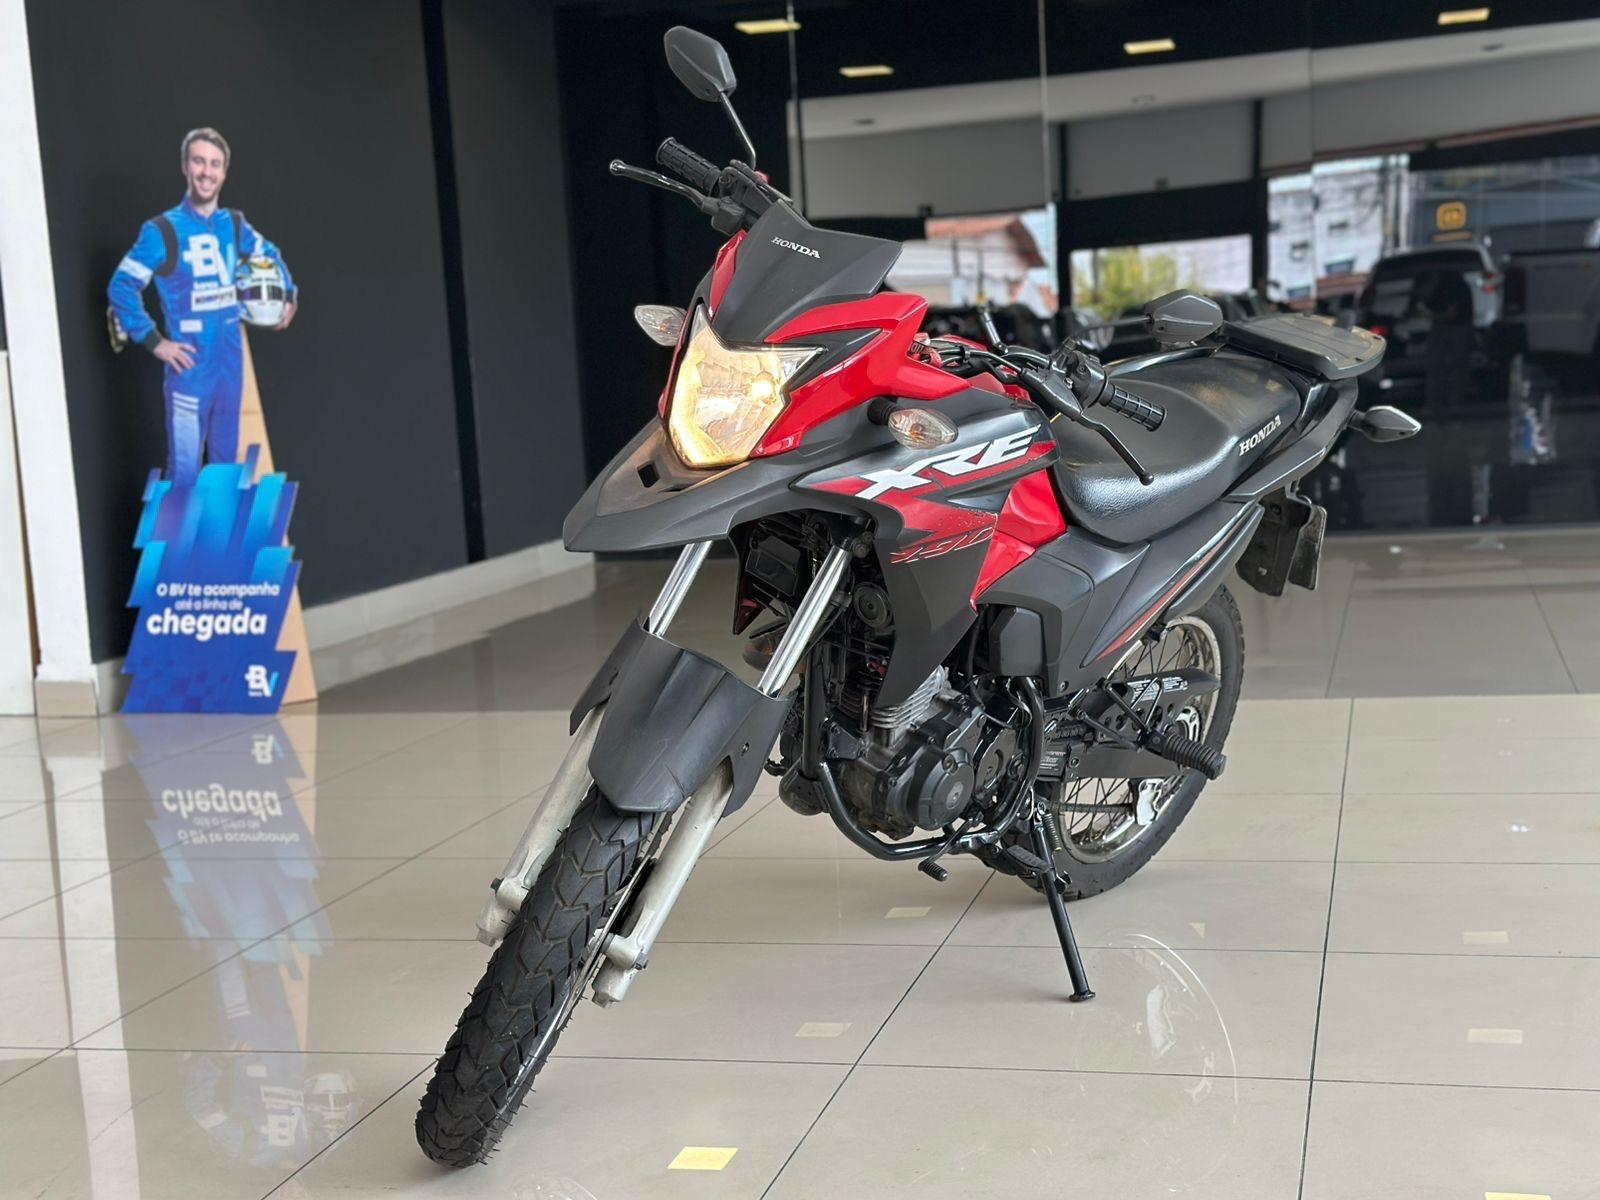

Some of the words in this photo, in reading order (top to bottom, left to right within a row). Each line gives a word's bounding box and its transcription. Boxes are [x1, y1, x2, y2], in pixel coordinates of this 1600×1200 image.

[771, 236, 821, 259] HONDA
[1238, 414, 1282, 457] HONDA
[855, 424, 1042, 500] XRE
[156, 583, 168, 597] O
[169, 583, 187, 597] BV
[188, 584, 202, 596] te
[203, 581, 280, 599] acompanha
[146, 607, 267, 641] chegada
[244, 664, 279, 697] BV
